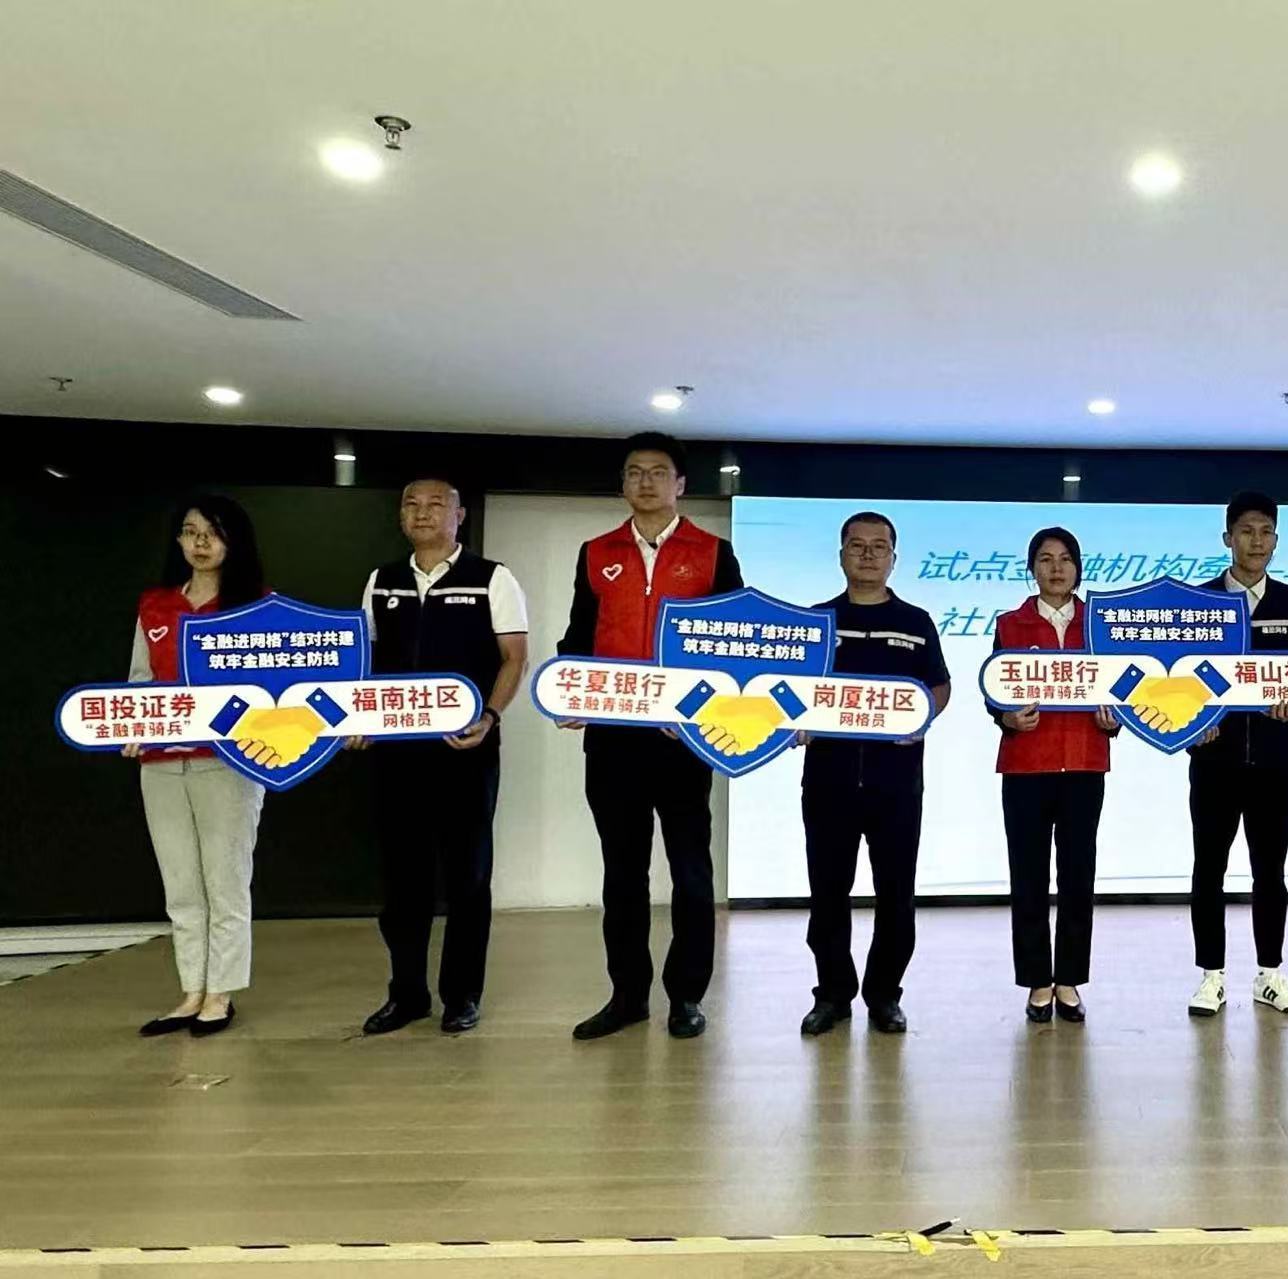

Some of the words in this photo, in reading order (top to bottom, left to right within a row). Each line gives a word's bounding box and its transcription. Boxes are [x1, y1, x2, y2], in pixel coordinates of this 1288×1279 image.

[1097, 609, 1236, 623] “金融进网格”结对共建
[671, 618, 821, 643] “金融进网格”结对共建
[1111, 627, 1223, 641] 筑牢金融安全防线
[193, 631, 354, 650] “金融进网格”结对共建
[683, 638, 805, 660] 筑牢金融安全防线
[209, 651, 339, 669] 筑牢金融安全防线
[1000, 660, 1099, 683] 玉山银行
[556, 666, 667, 699] 华夏银行
[1004, 685, 1093, 699] “金融青骑兵”
[352, 685, 461, 712] 福南社区
[561, 694, 661, 713] “金融青骑兵”
[814, 683, 917, 711] 岗厦社区
[81, 693, 196, 722] 国投证券
[86, 720, 190, 738] “金融青骑兵”
[384, 713, 431, 728] 网格员
[840, 712, 884, 727] 网格员
